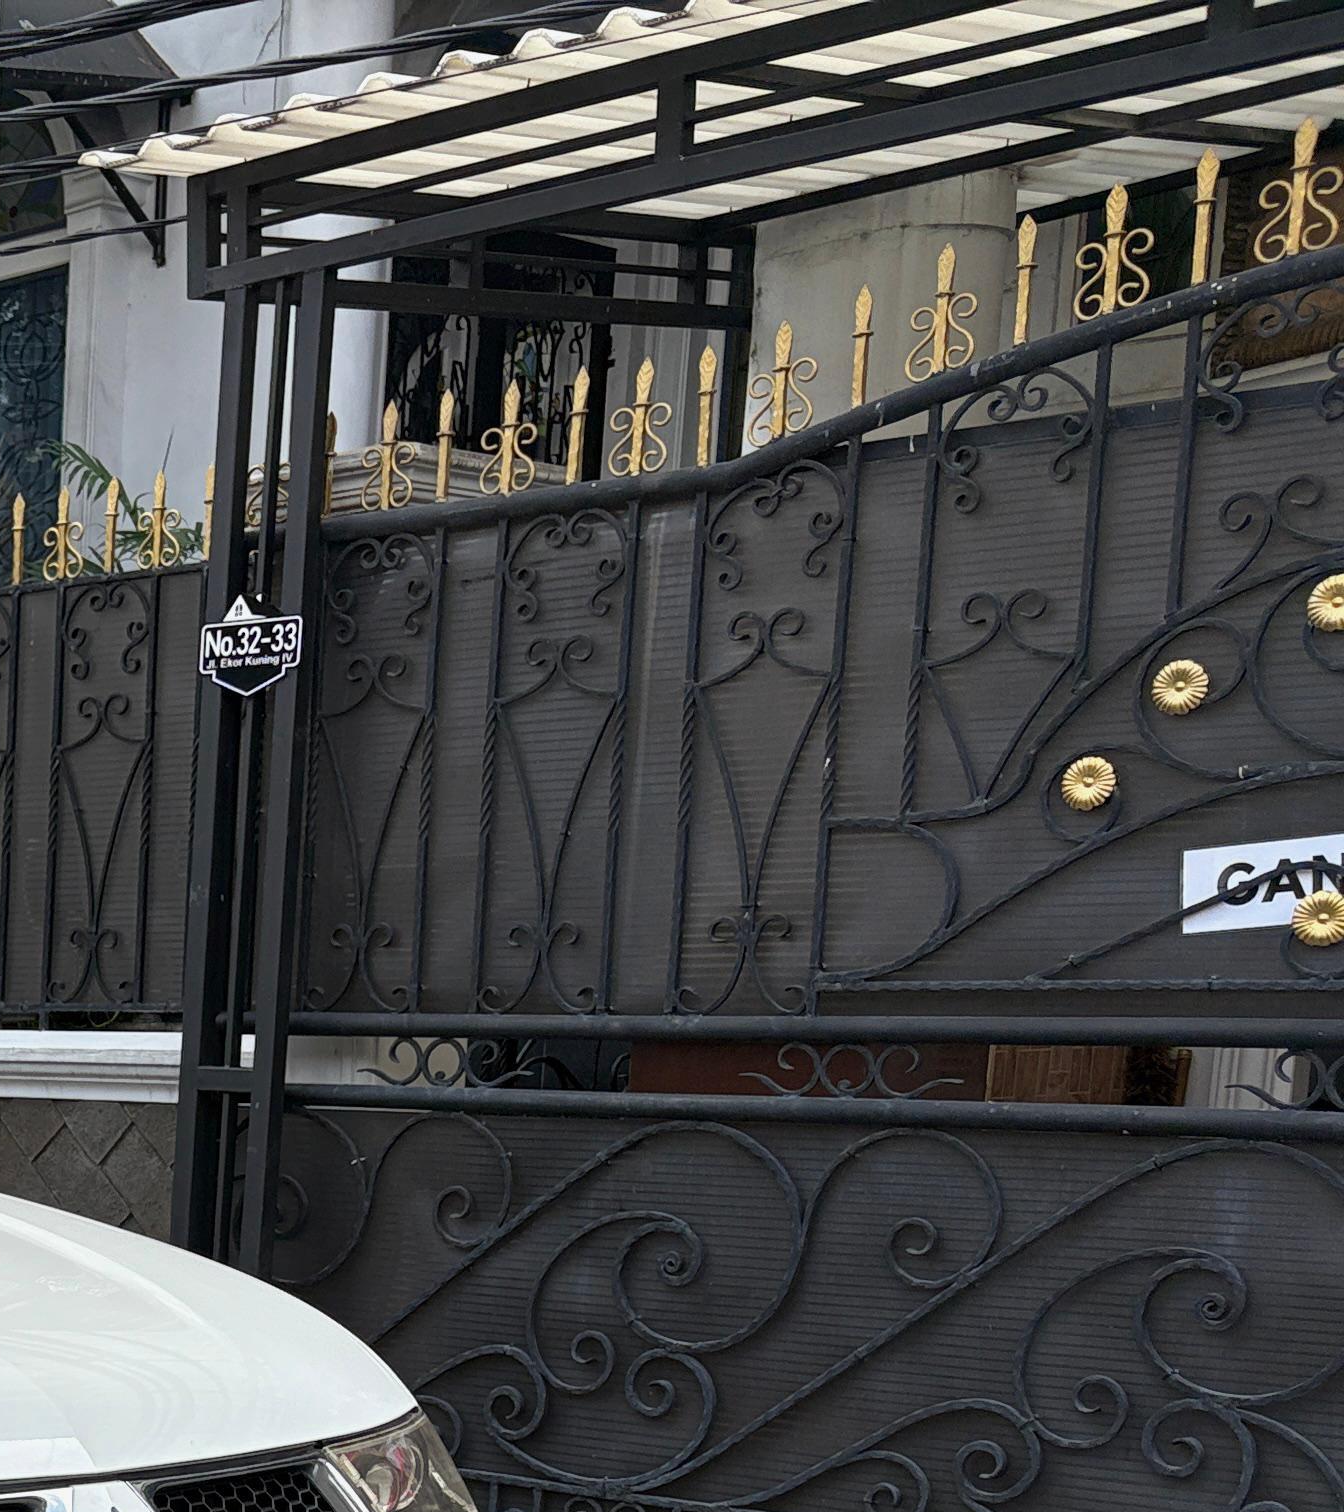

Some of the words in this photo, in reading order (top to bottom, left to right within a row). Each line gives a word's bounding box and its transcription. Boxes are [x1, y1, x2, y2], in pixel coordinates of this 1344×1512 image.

[204, 622, 298, 658] No.32-33
[220, 658, 243, 669] Ekor
[245, 655, 280, 667] Kuning
[282, 652, 293, 663] IV
